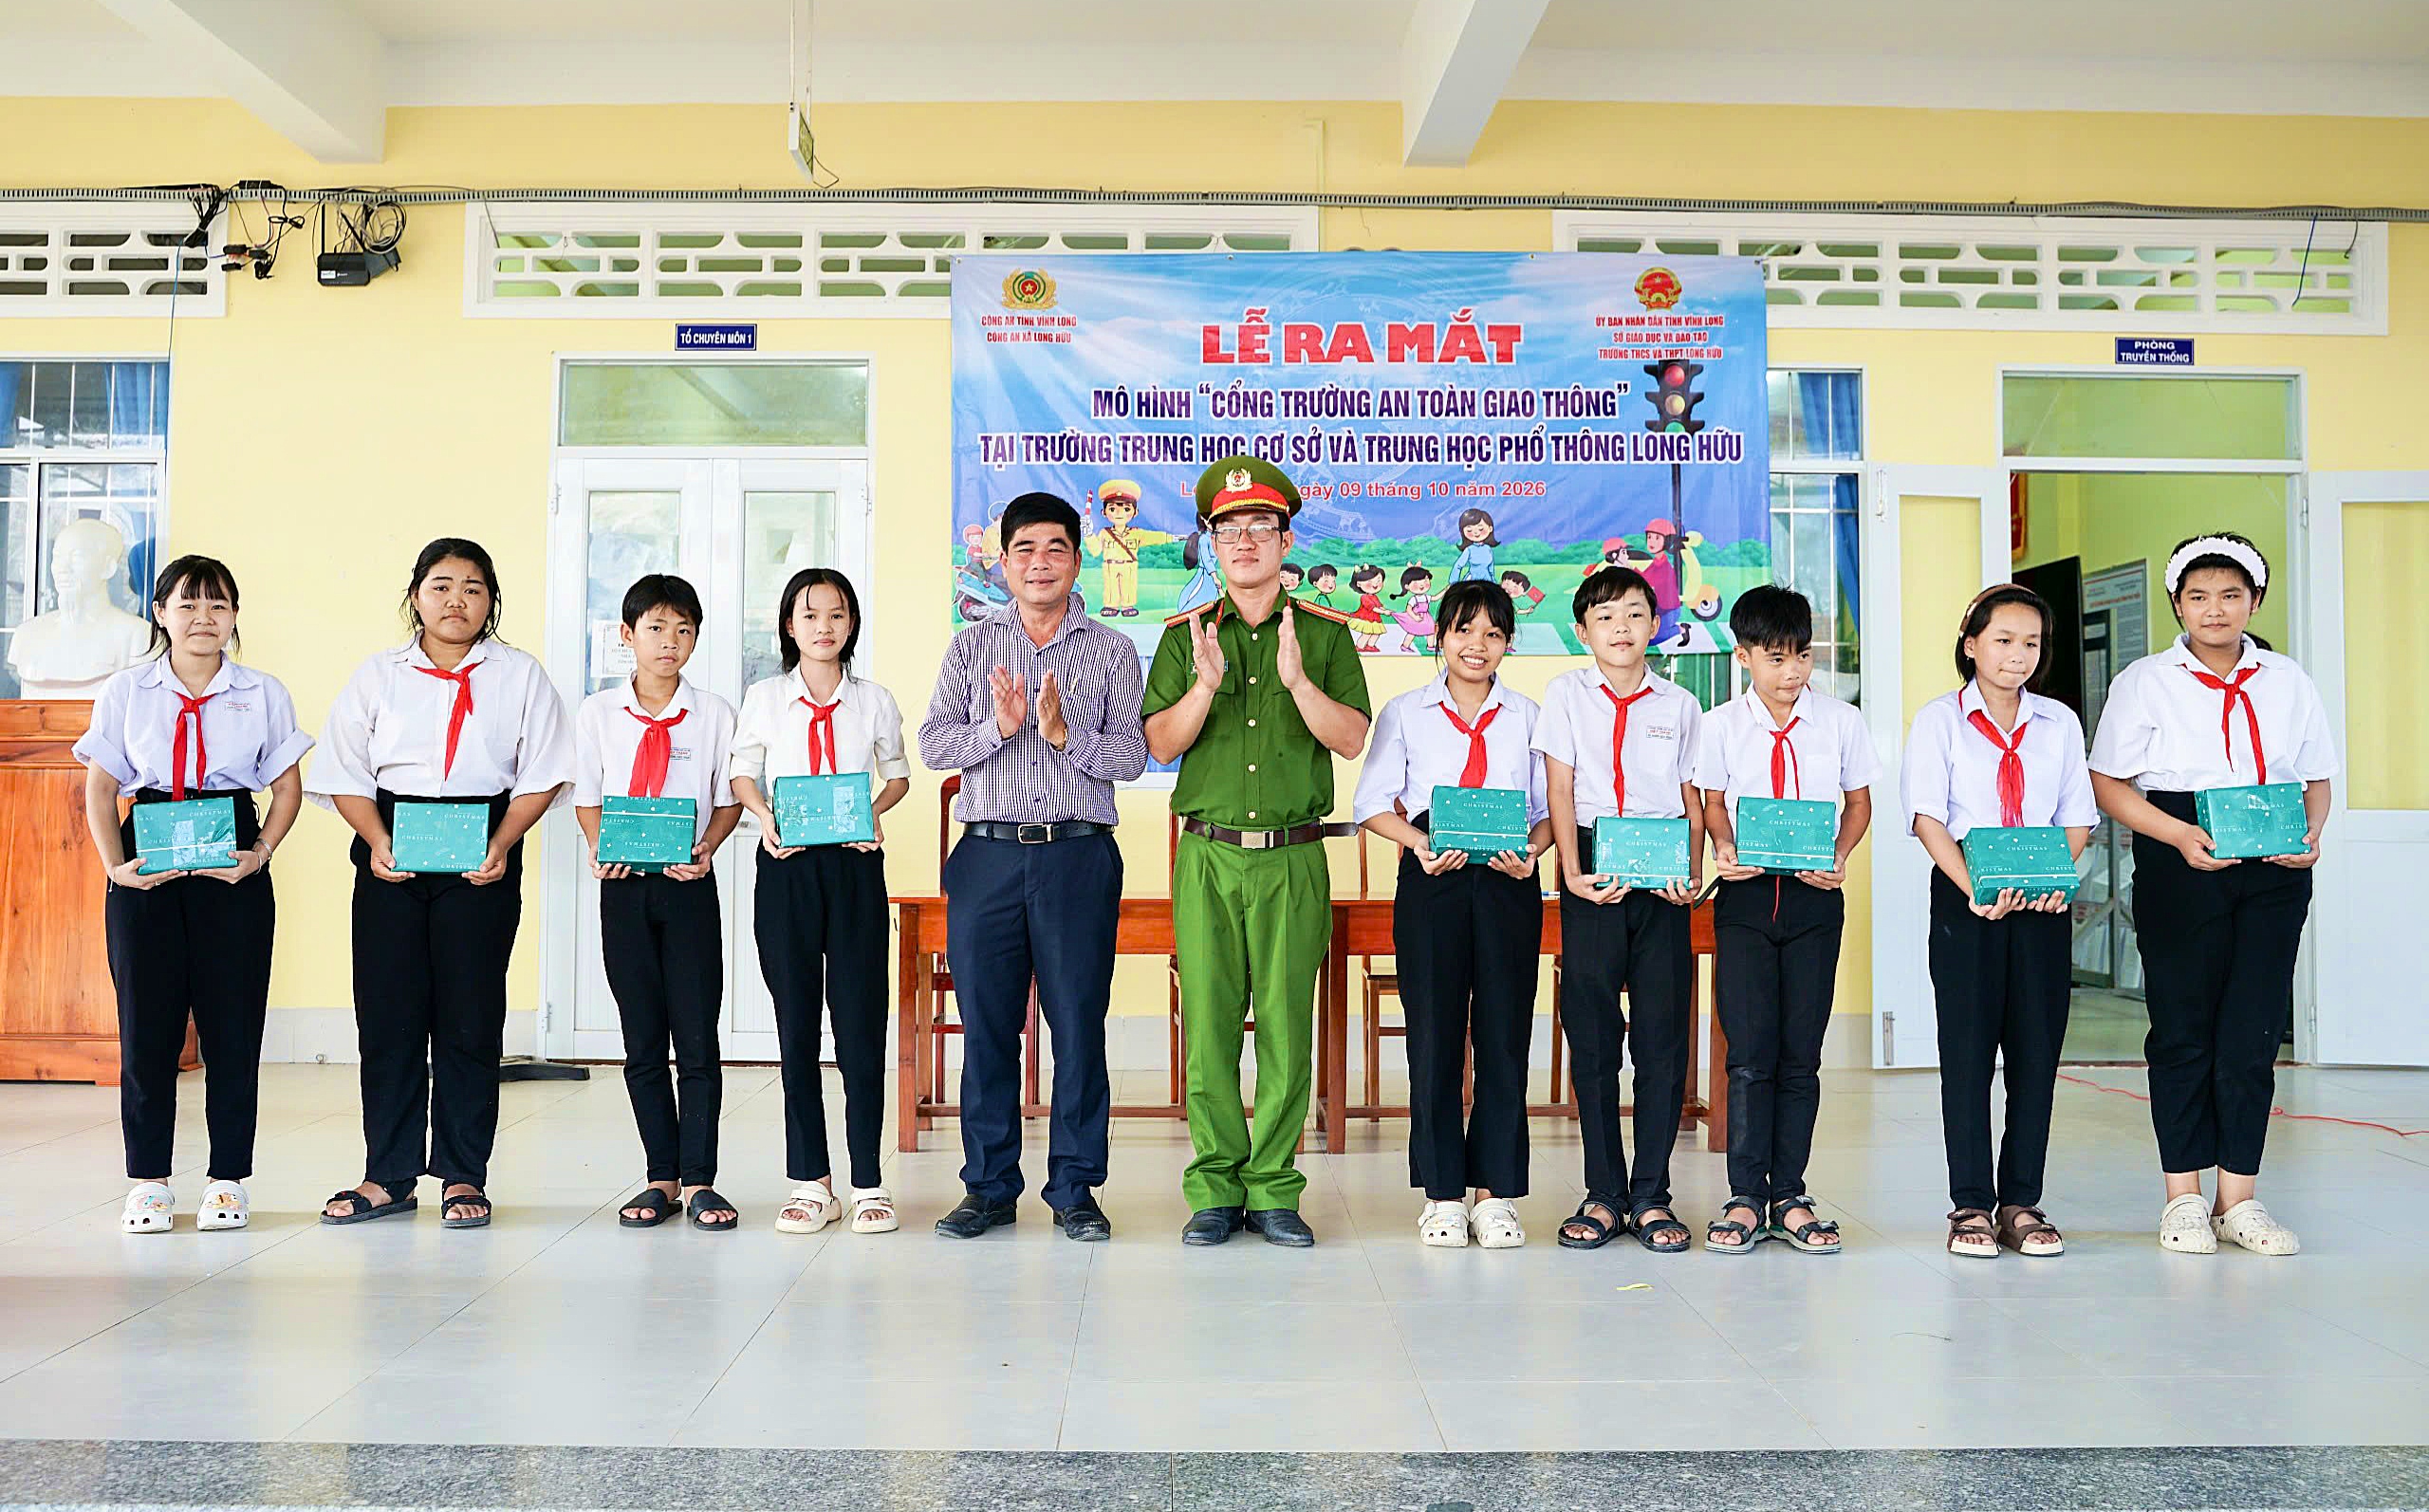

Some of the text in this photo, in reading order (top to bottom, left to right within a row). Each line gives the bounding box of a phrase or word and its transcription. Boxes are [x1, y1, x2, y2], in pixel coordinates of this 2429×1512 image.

[679, 327, 751, 344] TỔ CHUYÊN MÔN 1
[1201, 306, 1522, 364] LỄ RA MẮT
[2134, 340, 2175, 350] PHÒNG
[2158, 350, 2190, 362] THỐNG
[1092, 385, 1129, 418] MÔ
[1138, 383, 1192, 418] HÌNH
[1280, 382, 1371, 418] TRƯỜNG
[1378, 390, 1410, 417] AN
[1417, 382, 1476, 417] TOÀN
[1483, 390, 1535, 417] GIAO
[980, 435, 1015, 470] TẠI
[1021, 428, 1112, 464] TRƯỜNG
[1119, 435, 1194, 463] TRUNG
[1254, 433, 1285, 463] CƠ
[1291, 426, 1322, 463] SỞ
[1328, 428, 1357, 463] VÀ
[1364, 435, 1439, 463] TRUNG
[1446, 435, 1492, 470] HỌC
[1499, 424, 1546, 463] PHỔ
[1552, 429, 1624, 463] THÔNG
[1632, 435, 1691, 463] LONG
[1698, 430, 1743, 463] HỮU
[1340, 481, 1363, 497] 09
[1366, 481, 1421, 500] tháng
[1428, 481, 1449, 496] 10
[1455, 482, 1495, 496] năm
[1502, 481, 1547, 497] 2026
